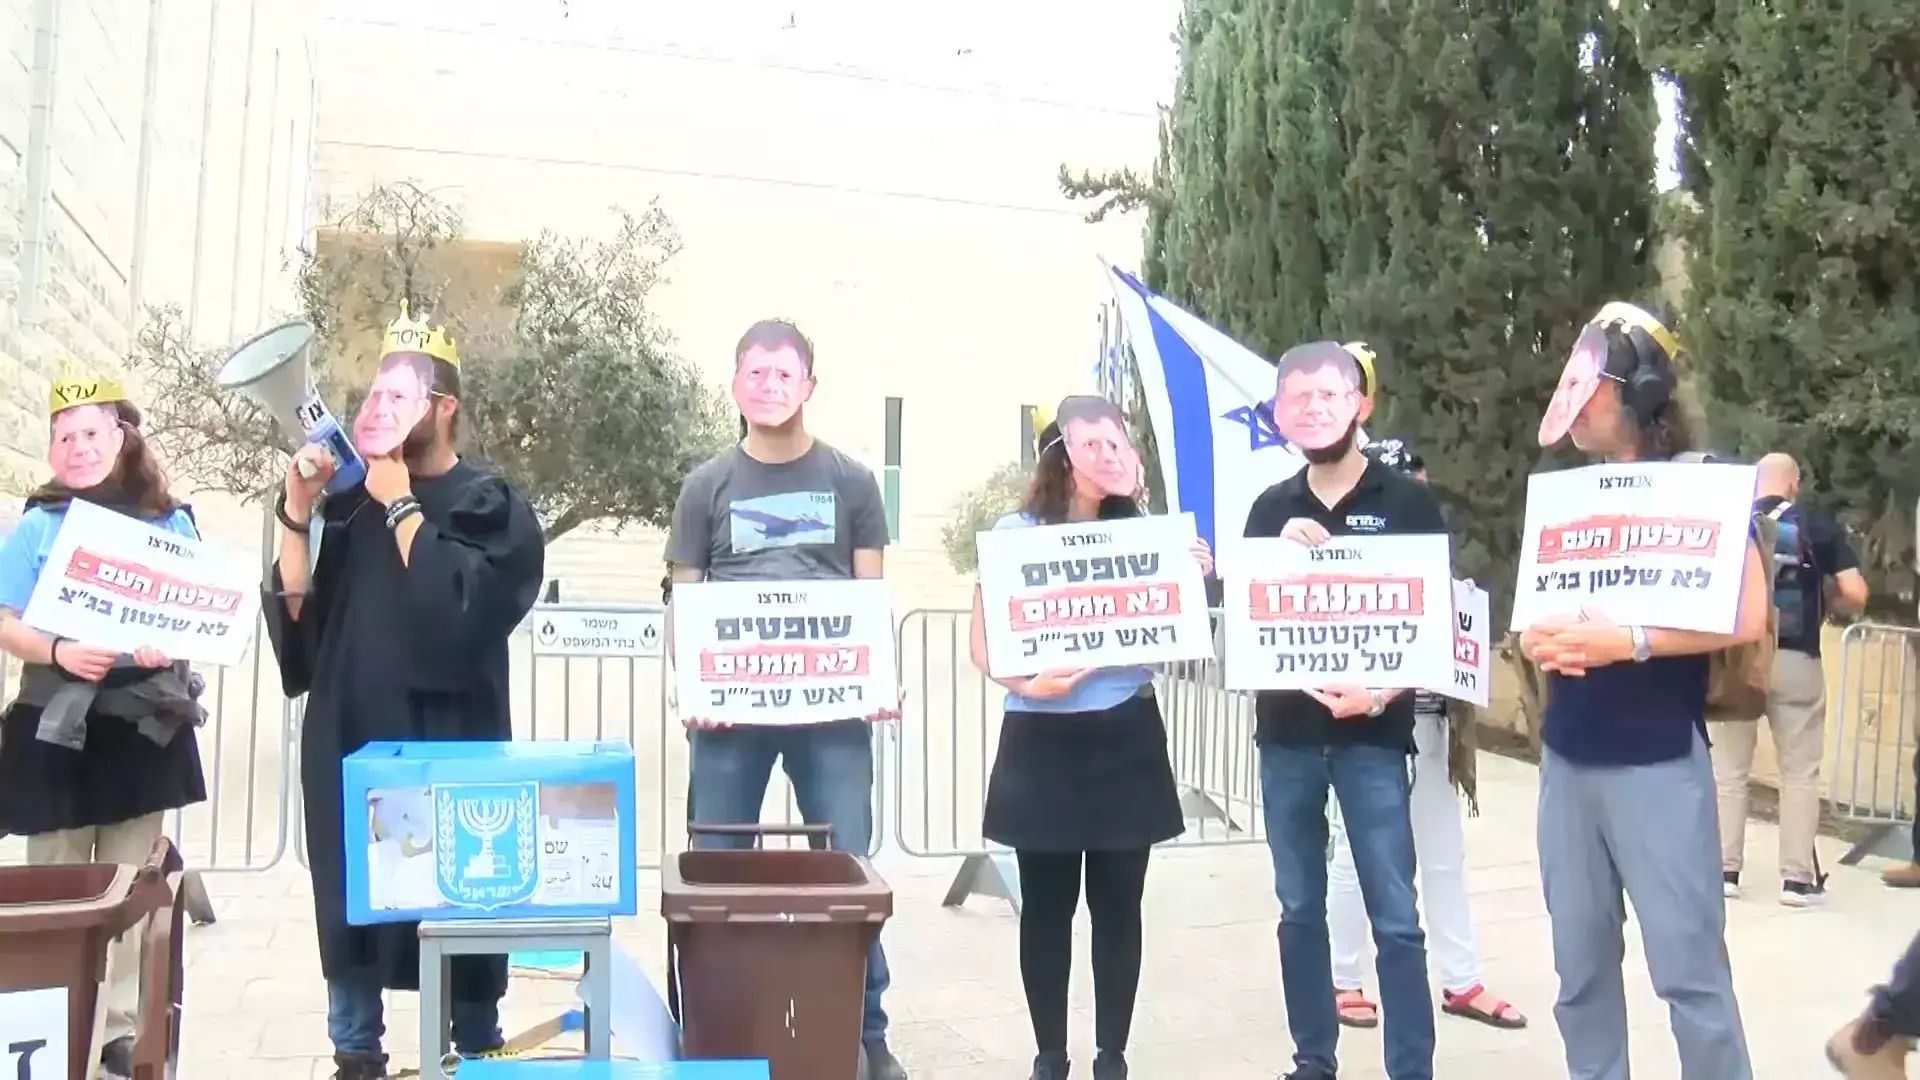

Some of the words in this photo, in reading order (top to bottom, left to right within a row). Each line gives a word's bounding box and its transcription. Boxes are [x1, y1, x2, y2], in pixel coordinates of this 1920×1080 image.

[389, 329, 431, 349] קיסר
[1561, 526, 1614, 552] העם
[1619, 521, 1714, 553] שלטון
[96, 561, 154, 595] העם
[1021, 551, 1160, 587] שופטים
[1589, 564, 1663, 594] שלטון
[1670, 566, 1713, 590] לא
[157, 580, 238, 613] שלטון
[1022, 594, 1117, 623] ממנים
[1125, 585, 1170, 614] לא
[1266, 582, 1411, 614] תתנגדו
[119, 605, 194, 633] שלטון
[196, 620, 230, 637] לא
[580, 617, 618, 630] משמר
[714, 615, 852, 641] שופטים
[562, 636, 610, 648] המשפט
[614, 637, 635, 648] בתי
[1115, 624, 1177, 648] ראש
[1259, 620, 1418, 649] לדיקטטורה
[713, 652, 807, 676] ממנים
[815, 647, 859, 674] לא
[1275, 651, 1350, 674] עמית
[1360, 648, 1403, 672] של
[803, 685, 863, 706] ראש
